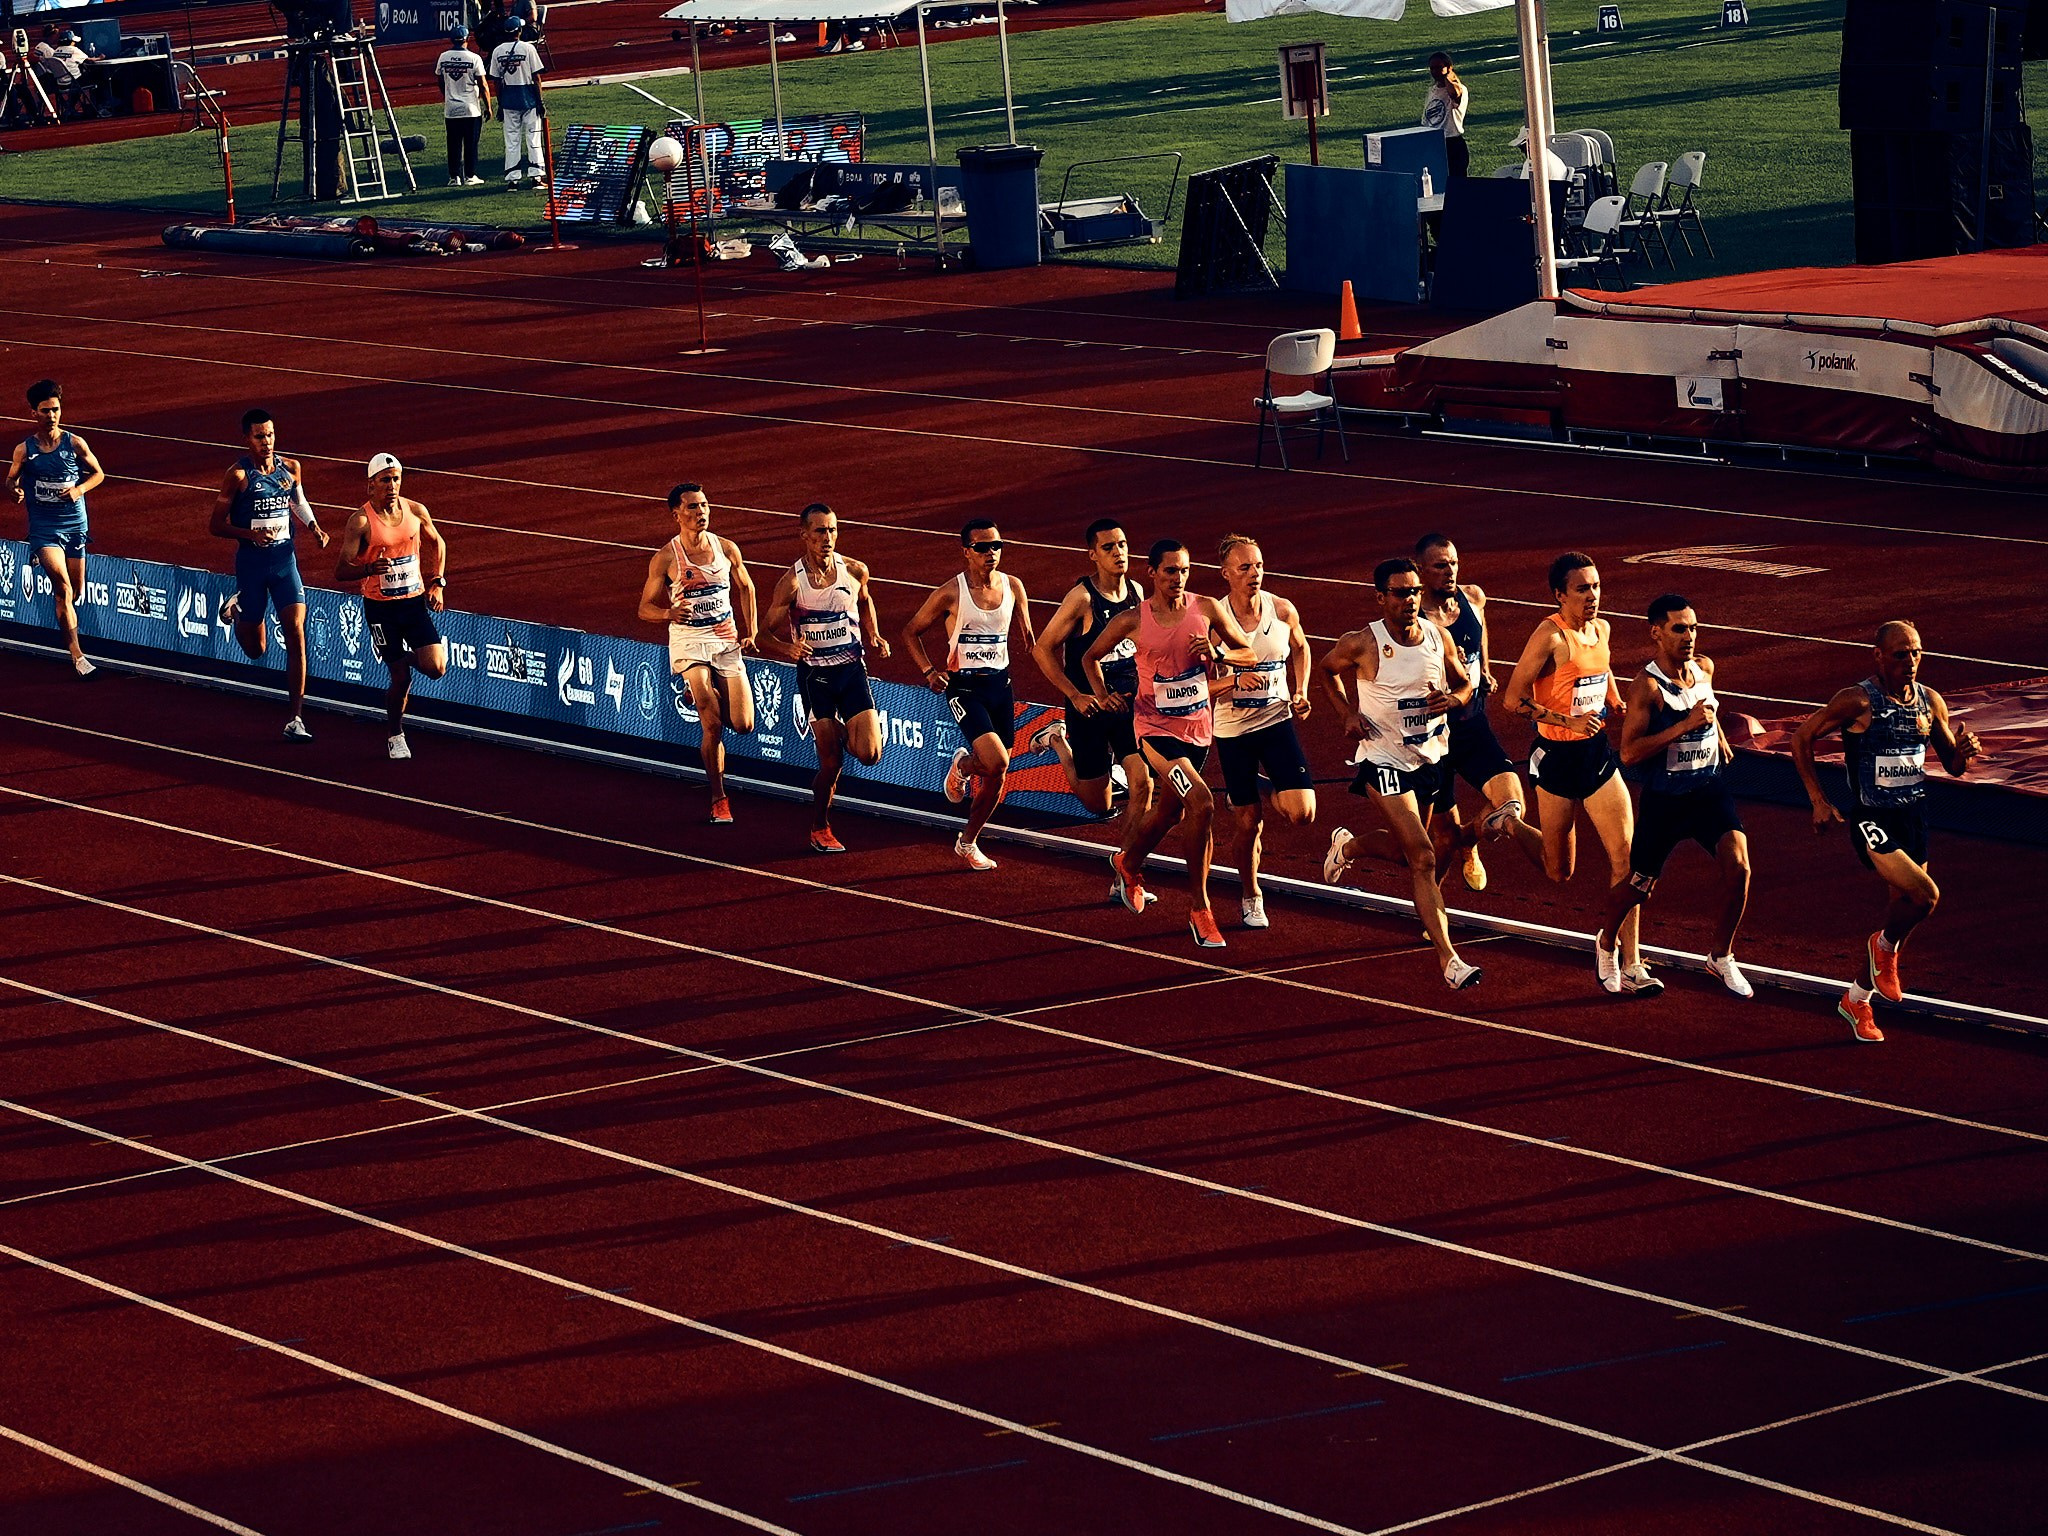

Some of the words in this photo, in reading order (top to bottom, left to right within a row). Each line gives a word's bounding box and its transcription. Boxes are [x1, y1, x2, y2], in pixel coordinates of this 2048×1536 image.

[392, 9, 418, 24] ВФЛА
[440, 10, 460, 31] ПСБ
[1602, 15, 1618, 28] 16
[1726, 9, 1741, 22] 18
[87, 581, 109, 606] ПСБ
[116, 587, 136, 610] 2026
[194, 592, 208, 619] 60
[805, 627, 847, 641] ПОЛТАНОВ
[450, 642, 477, 669] ПСБ
[486, 649, 509, 672] 2026
[578, 657, 593, 685] 60
[1166, 685, 1199, 699] ШАРОВ
[892, 717, 923, 748] ПСБ
[1677, 748, 1711, 762] ВОЛКОВ
[1170, 768, 1191, 794] 12
[1378, 769, 1398, 794] 14
